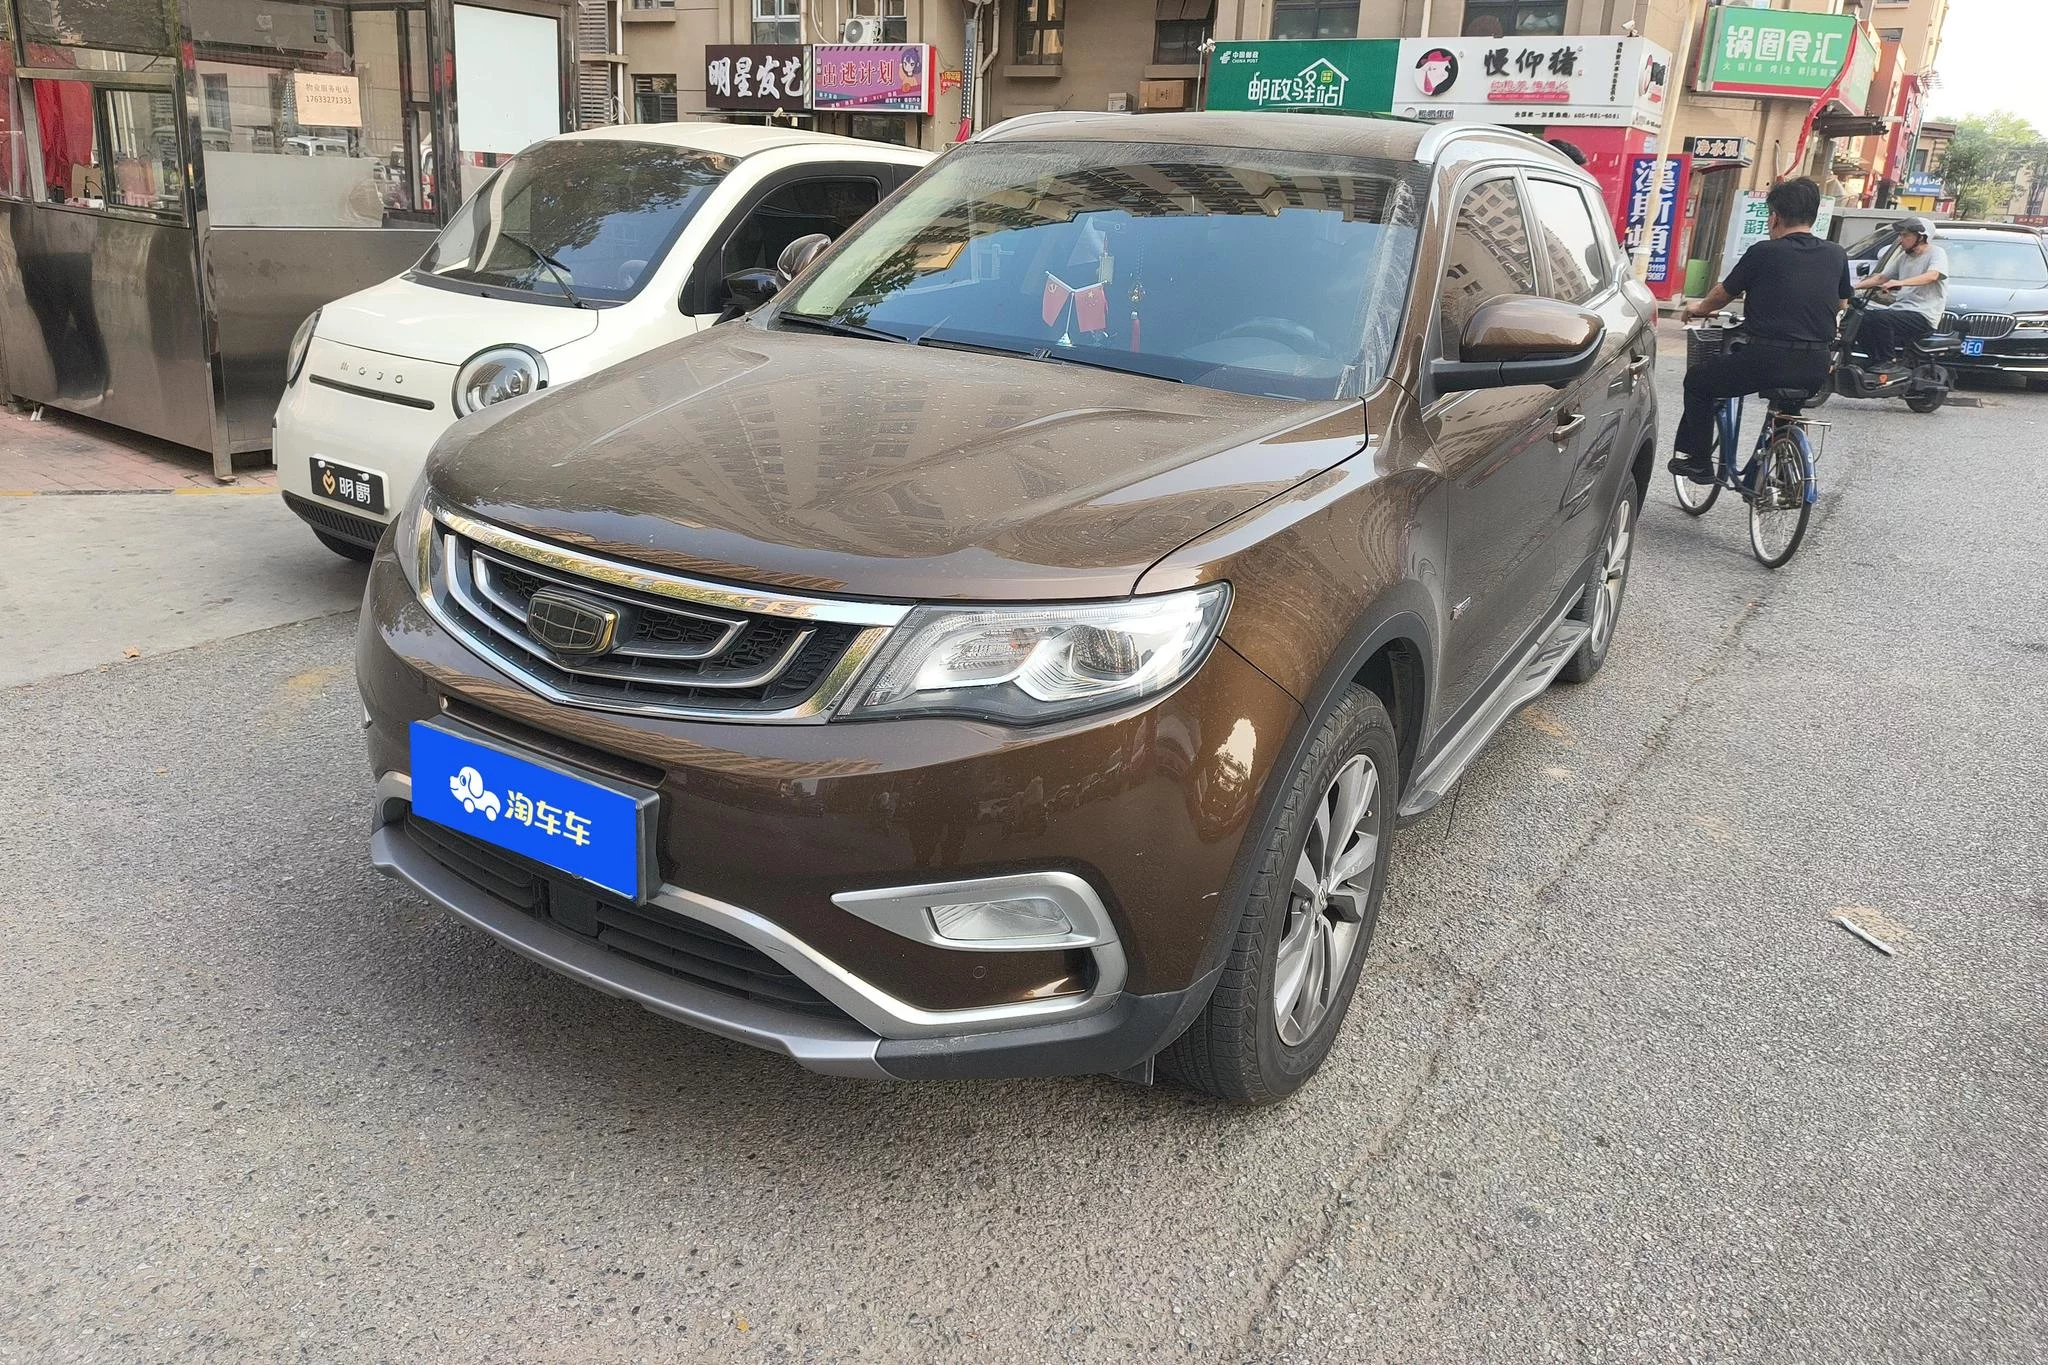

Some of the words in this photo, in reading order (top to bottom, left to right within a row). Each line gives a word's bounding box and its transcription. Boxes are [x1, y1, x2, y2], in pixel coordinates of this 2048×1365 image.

[1232, 51, 1259, 59] 中国邮政
[1725, 25, 1842, 65] 锅圈食汇
[708, 55, 803, 99] 明星发艺
[823, 58, 895, 88] 出逃计划
[305, 95, 352, 104] 17633271333
[1248, 71, 1340, 106] 邮政驿站
[1695, 139, 1739, 157] 净水机
